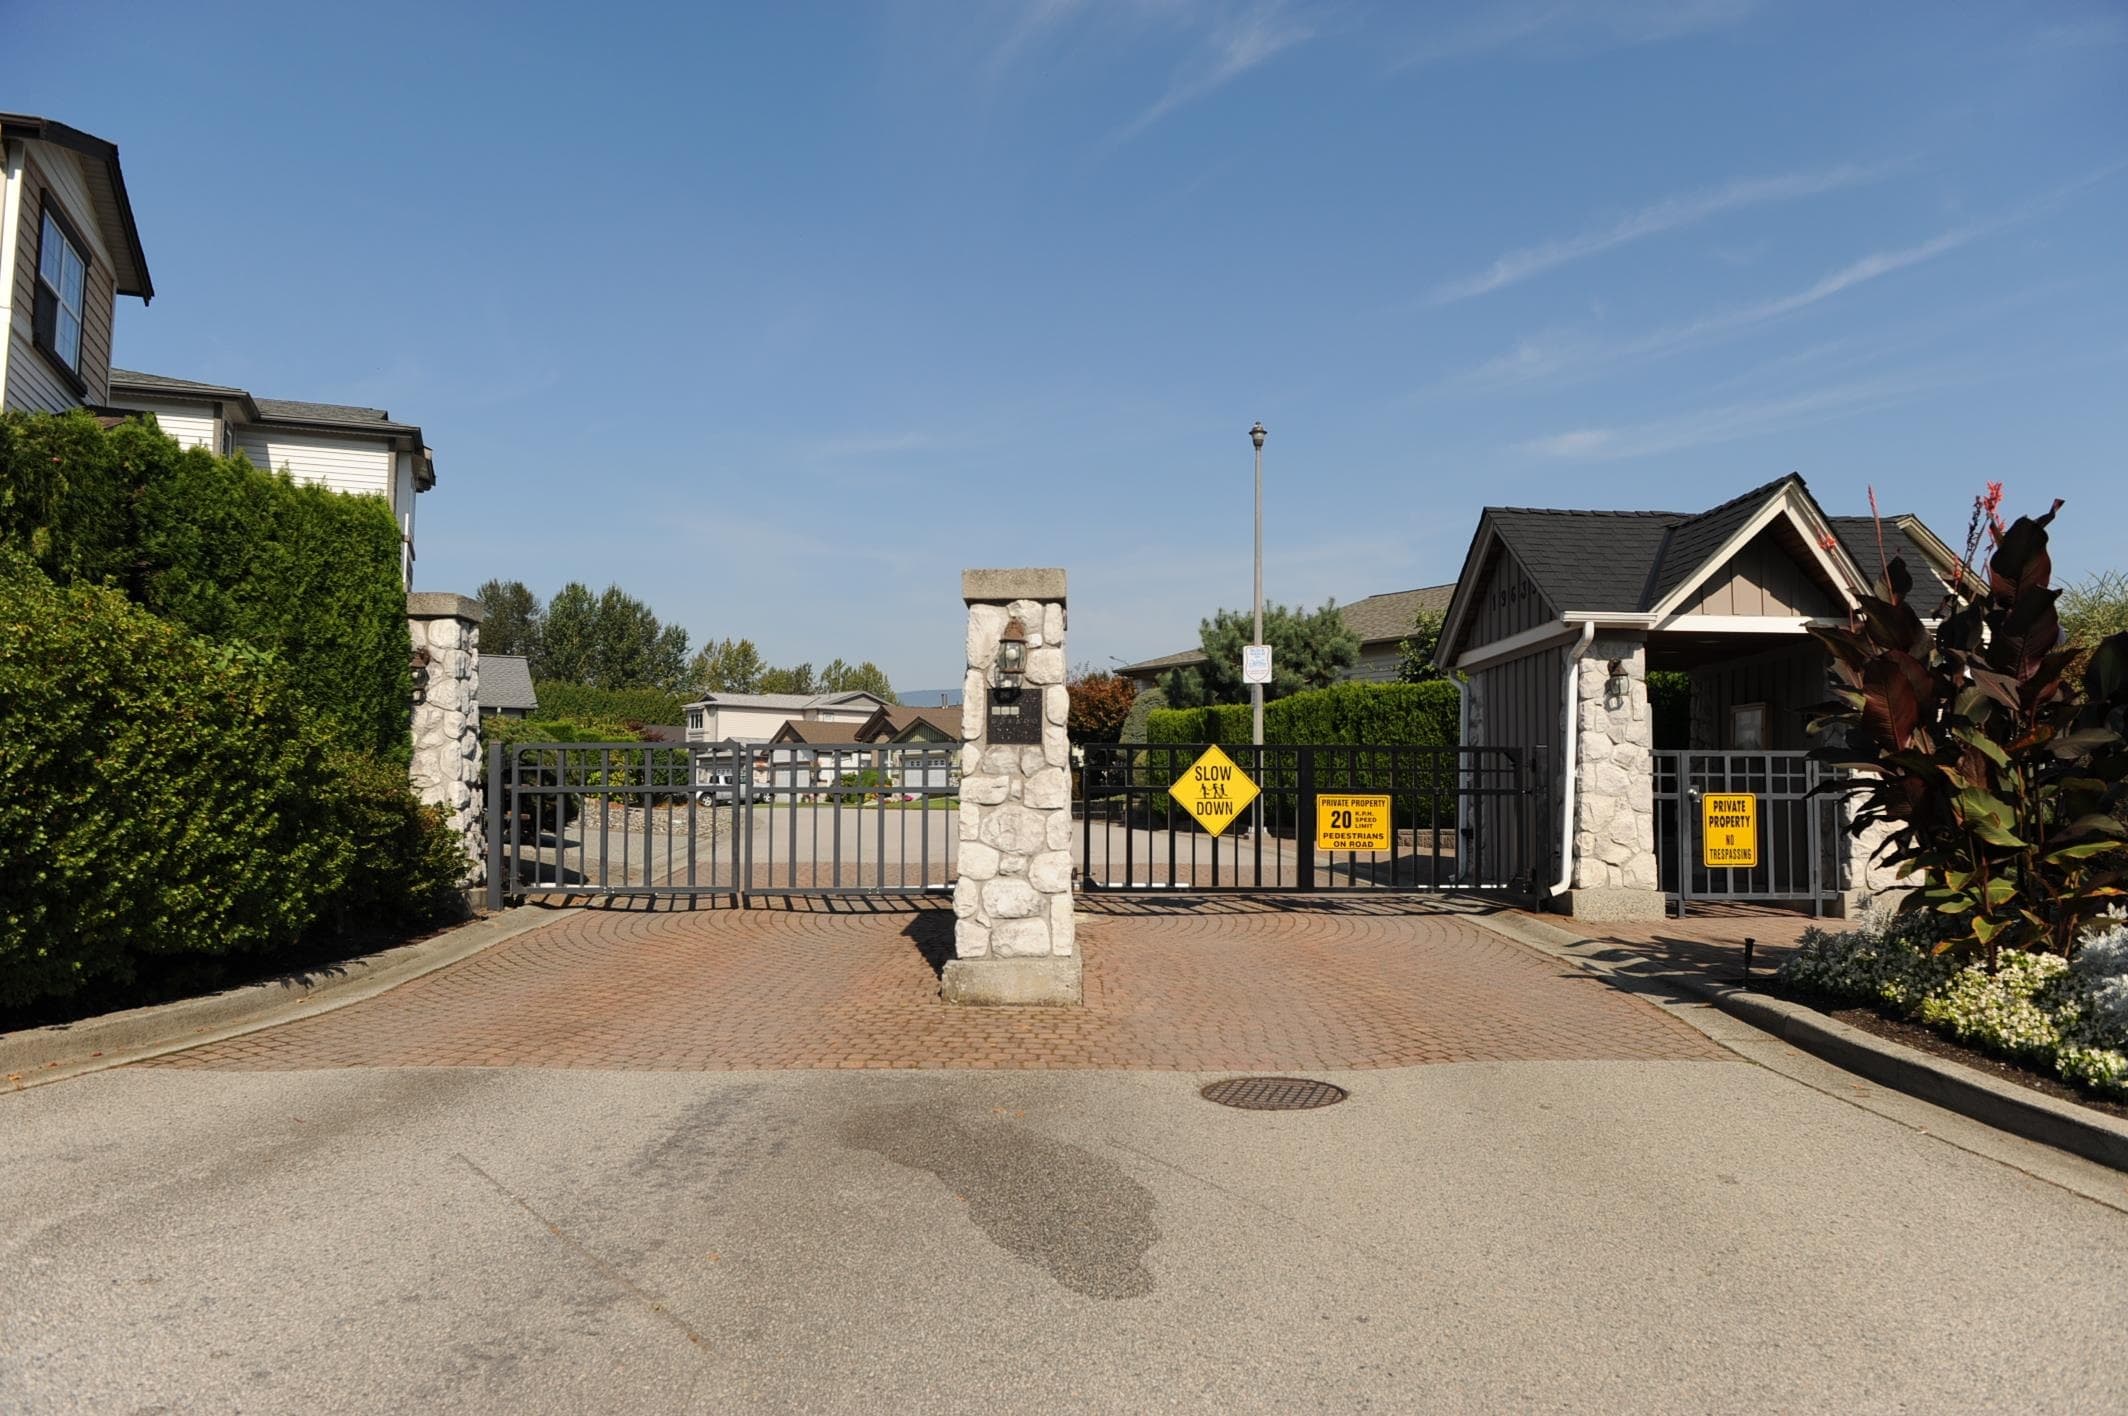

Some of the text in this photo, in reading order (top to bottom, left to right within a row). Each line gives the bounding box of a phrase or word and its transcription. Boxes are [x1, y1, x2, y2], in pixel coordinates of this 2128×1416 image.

[1195, 766, 1232, 781] SLOW
[1196, 801, 1233, 815] DOWN
[1321, 799, 1386, 807] PRIVATE PROPERTY
[1713, 800, 1746, 812] PRIVATE
[1330, 810, 1352, 828] 20
[1709, 815, 1751, 828] PROPERTY
[1323, 832, 1384, 840] PEDESTRIANS
[1725, 834, 1735, 846] NO
[1709, 848, 1752, 860] TRESPASSING
